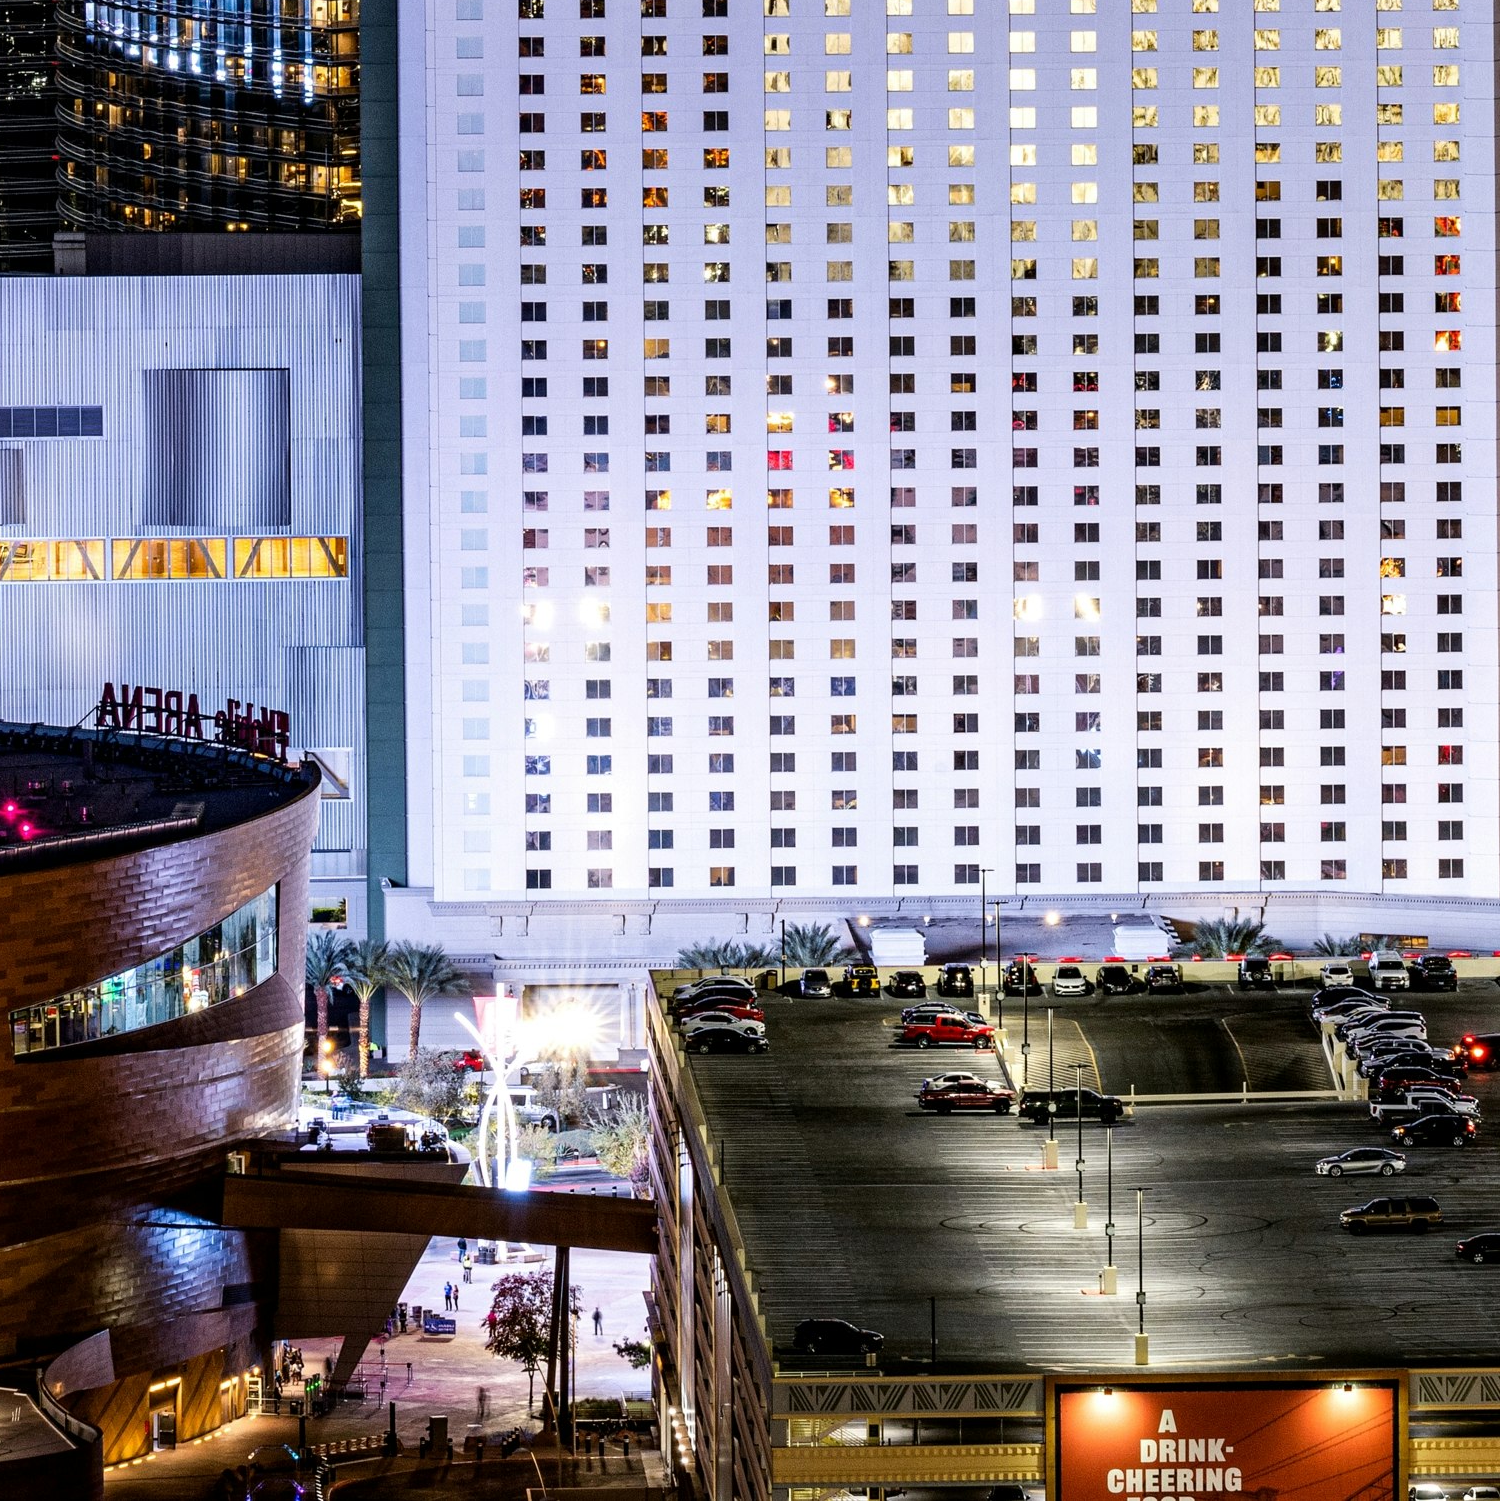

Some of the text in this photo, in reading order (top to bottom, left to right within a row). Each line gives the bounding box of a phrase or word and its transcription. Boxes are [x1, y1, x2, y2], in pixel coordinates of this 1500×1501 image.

[1157, 1409, 1178, 1434] A
[1139, 1437, 1235, 1464] DRINK-
[1106, 1466, 1243, 1494] CHEERING
